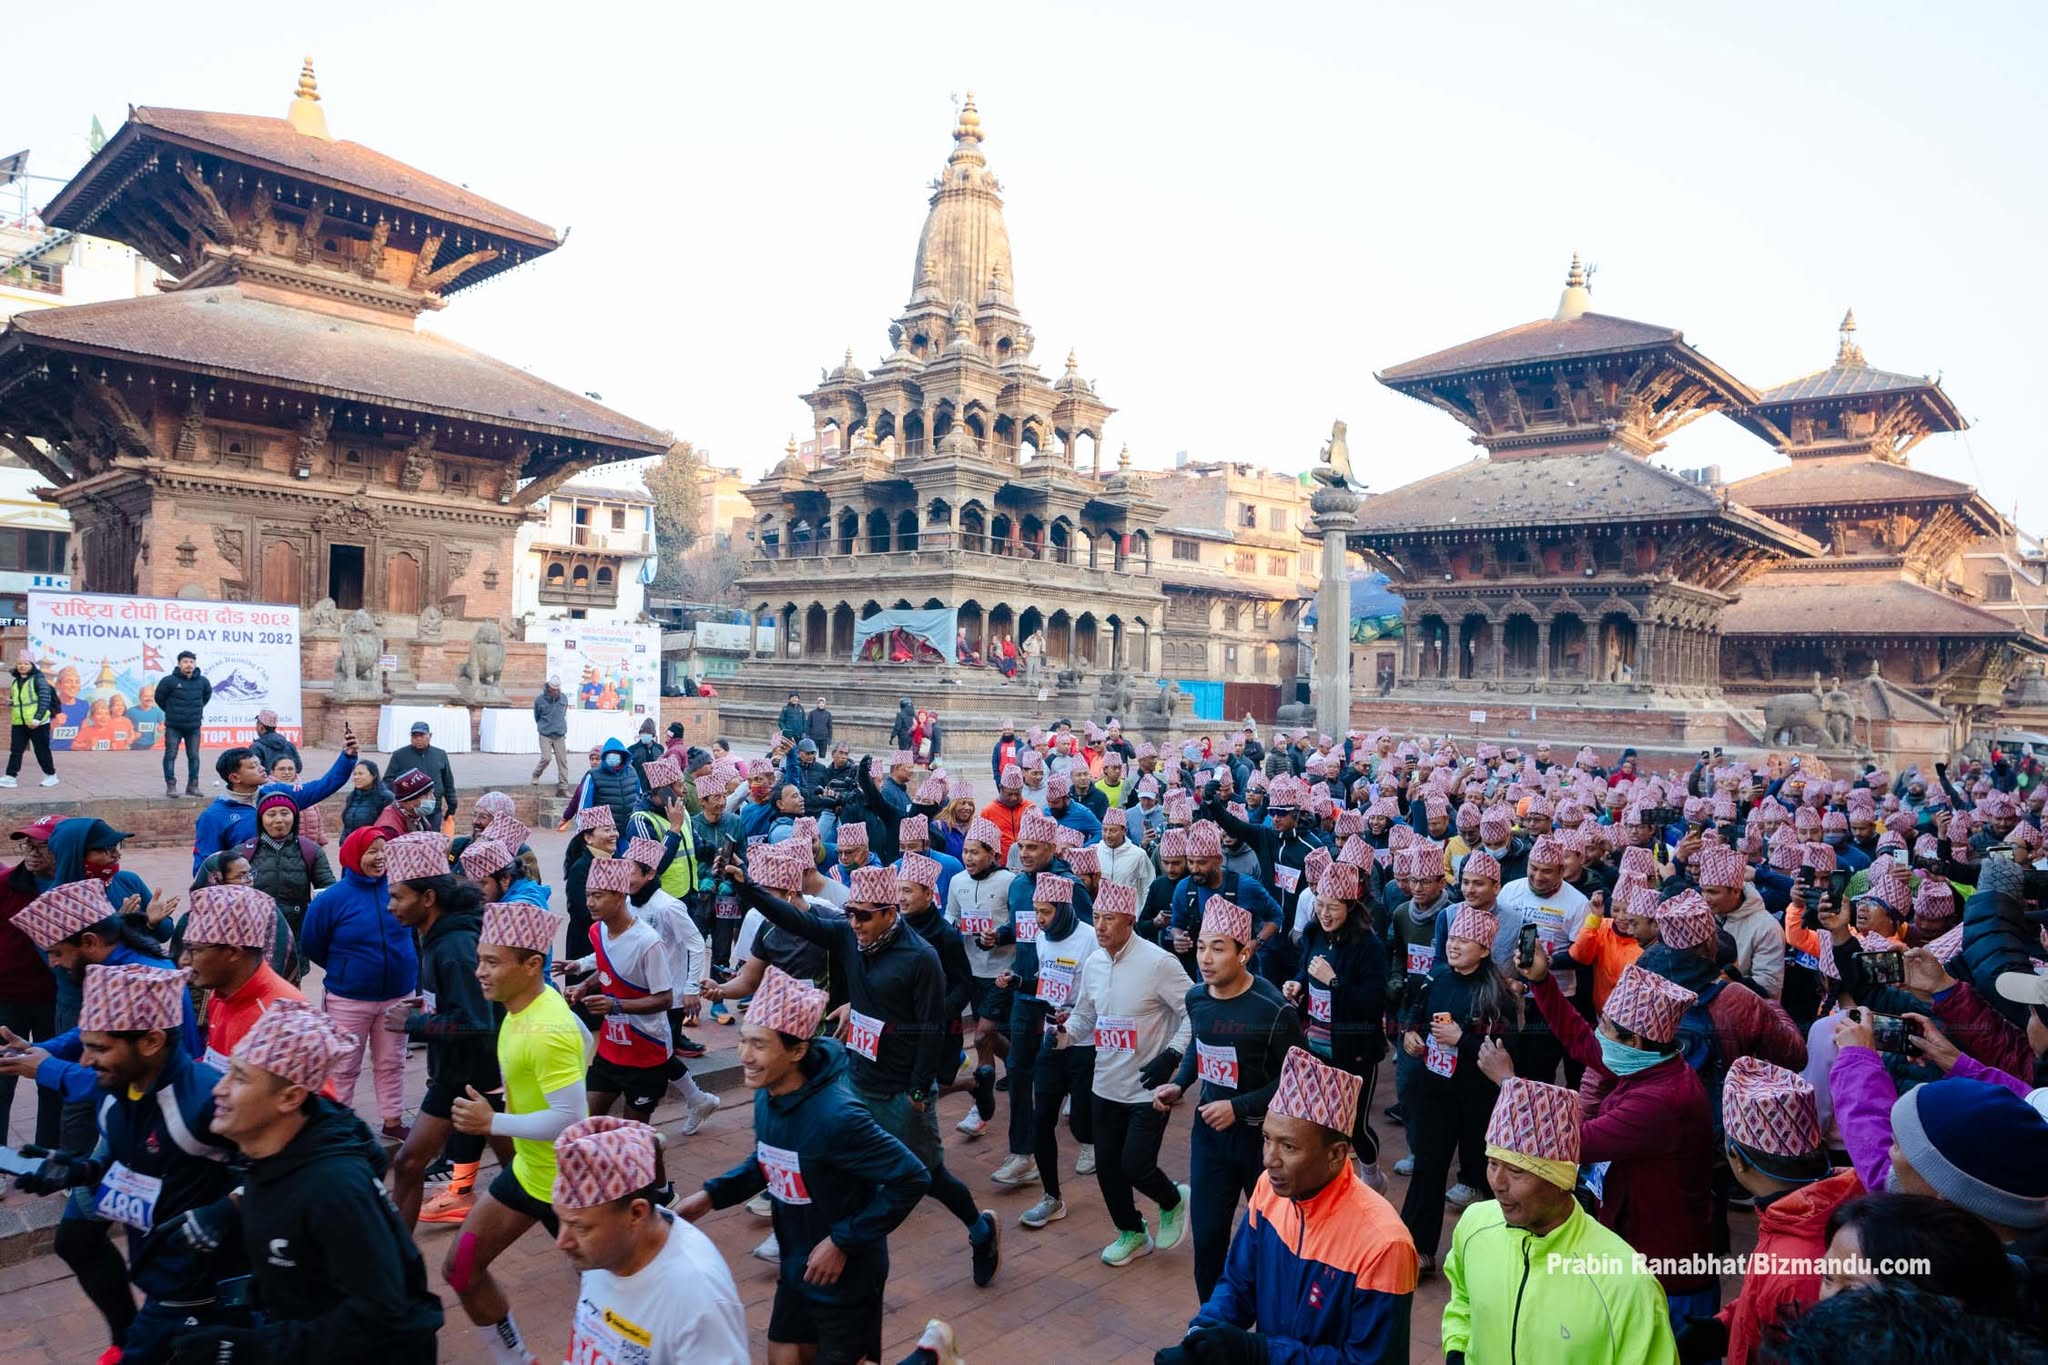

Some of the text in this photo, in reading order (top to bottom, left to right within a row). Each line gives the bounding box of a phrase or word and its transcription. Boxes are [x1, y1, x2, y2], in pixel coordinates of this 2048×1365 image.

[120, 601, 158, 621] टोपी
[164, 602, 209, 622] दिवस
[215, 606, 245, 625] दौड
[250, 612, 290, 627] २०८२
[51, 622, 140, 639] NATIONAL
[145, 626, 180, 640] TOPI
[186, 629, 217, 641] DAY
[222, 630, 254, 643] RUN
[259, 632, 293, 645] 2082
[56, 727, 77, 739] 1723
[203, 730, 235, 744] TOPI,
[1412, 955, 1433, 970] 92
[1042, 980, 1067, 1001] 859
[852, 1025, 874, 1056] 812
[1100, 1030, 1131, 1050] 801
[1428, 1047, 1453, 1074] 825
